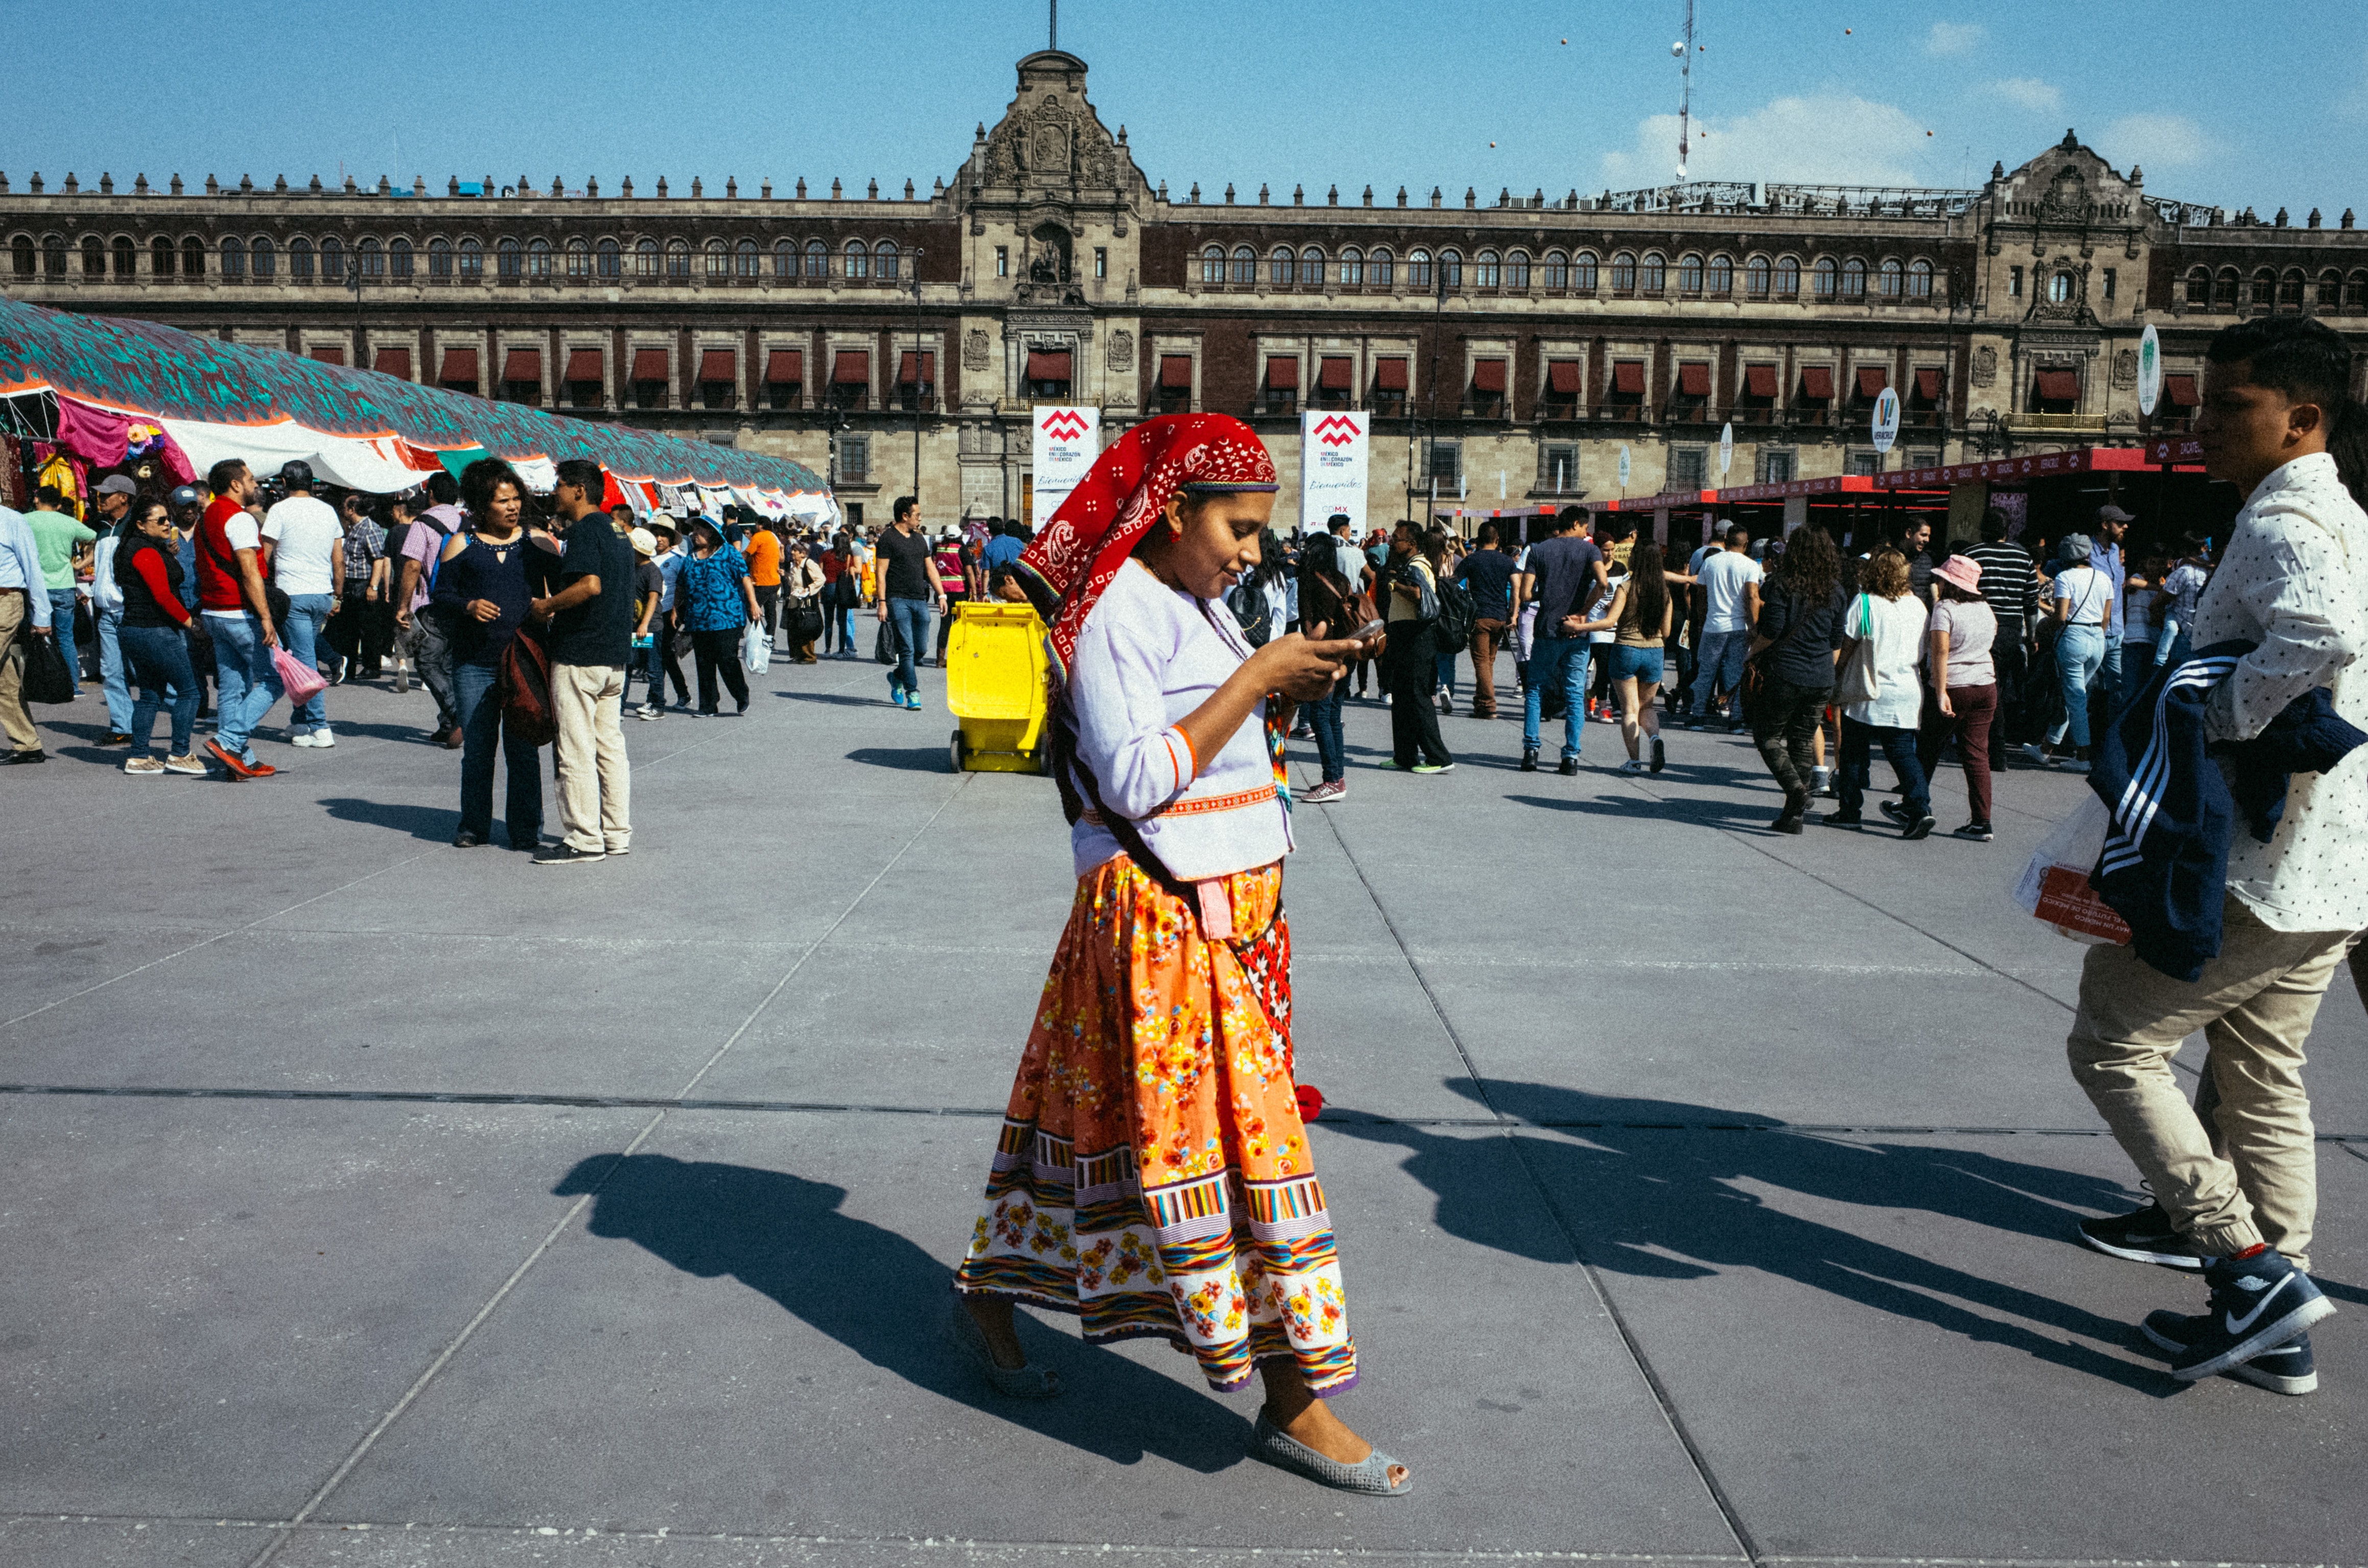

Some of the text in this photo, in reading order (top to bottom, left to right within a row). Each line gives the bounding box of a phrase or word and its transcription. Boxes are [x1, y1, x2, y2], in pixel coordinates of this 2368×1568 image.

[1874, 431, 1894, 439] VERACRUZ
[1038, 473, 1084, 485] Bienvenid
[2042, 897, 2070, 909] MÉXICO
[2081, 908, 2111, 920] FUTURO
[2115, 924, 2129, 933] HAY
